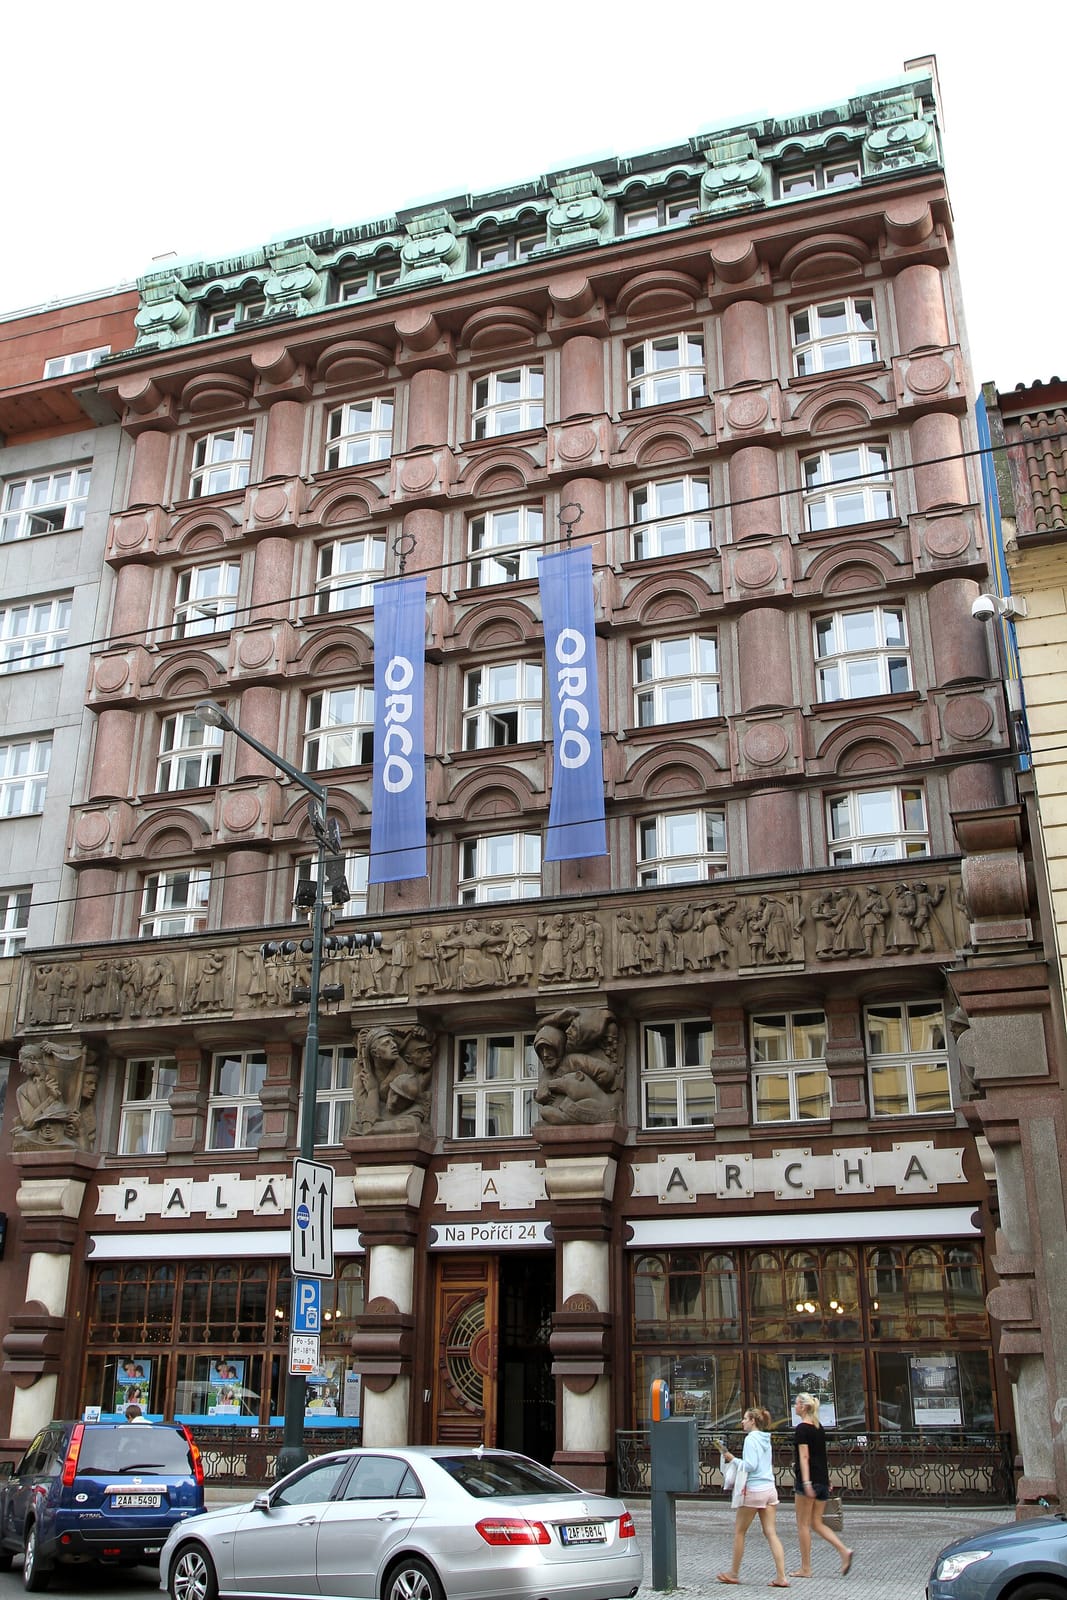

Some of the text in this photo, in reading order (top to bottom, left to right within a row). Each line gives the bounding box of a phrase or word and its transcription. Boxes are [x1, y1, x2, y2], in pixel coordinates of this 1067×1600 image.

[555, 627, 592, 769] ORCO
[382, 655, 414, 793] ORCO
[483, 1178, 498, 1195] A
[666, 1154, 928, 1192] ARCHA
[124, 1178, 278, 1210] PALÁ
[445, 1224, 537, 1241] Na Poříčí 24
[300, 1284, 316, 1315] P
[117, 1495, 158, 1505] 2AA 5490
[568, 1525, 602, 1539] 2AF 5814
